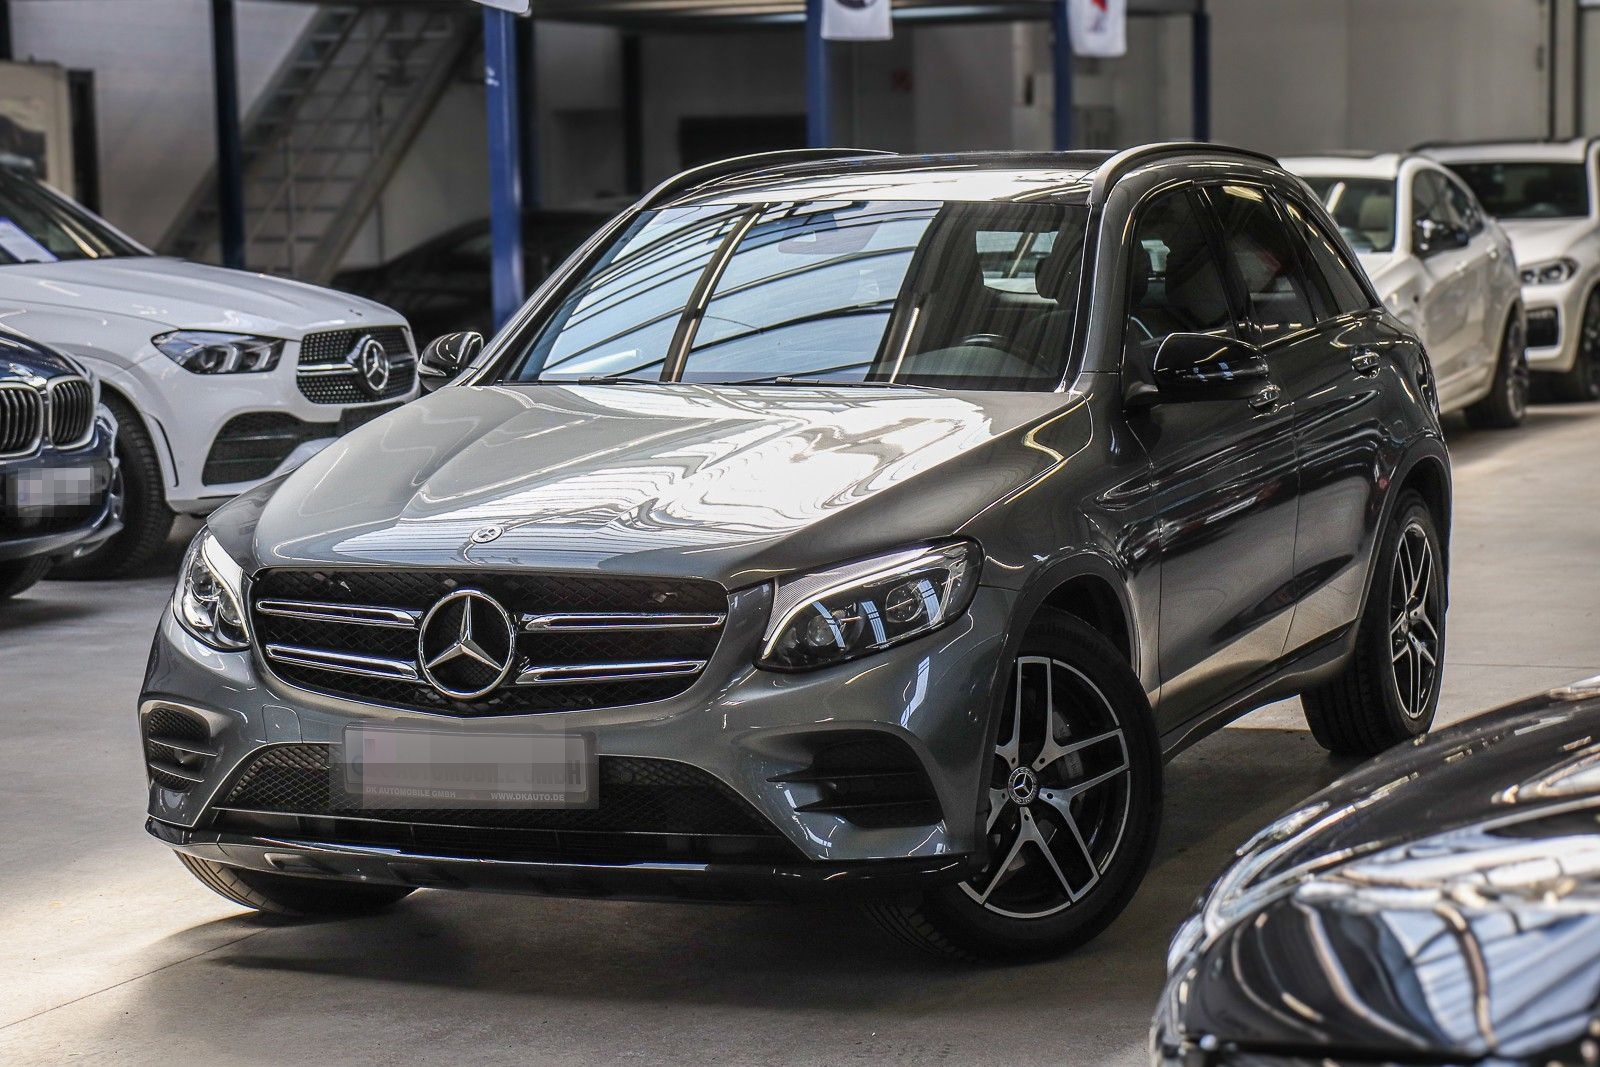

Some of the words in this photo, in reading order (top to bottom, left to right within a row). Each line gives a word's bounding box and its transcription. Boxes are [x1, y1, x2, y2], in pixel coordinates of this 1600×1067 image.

[365, 786, 378, 794] DK
[378, 787, 430, 797] AUTOMOBILE
[431, 789, 456, 798] GMBH
[490, 792, 565, 801] WWW.DKAUTO.DE
